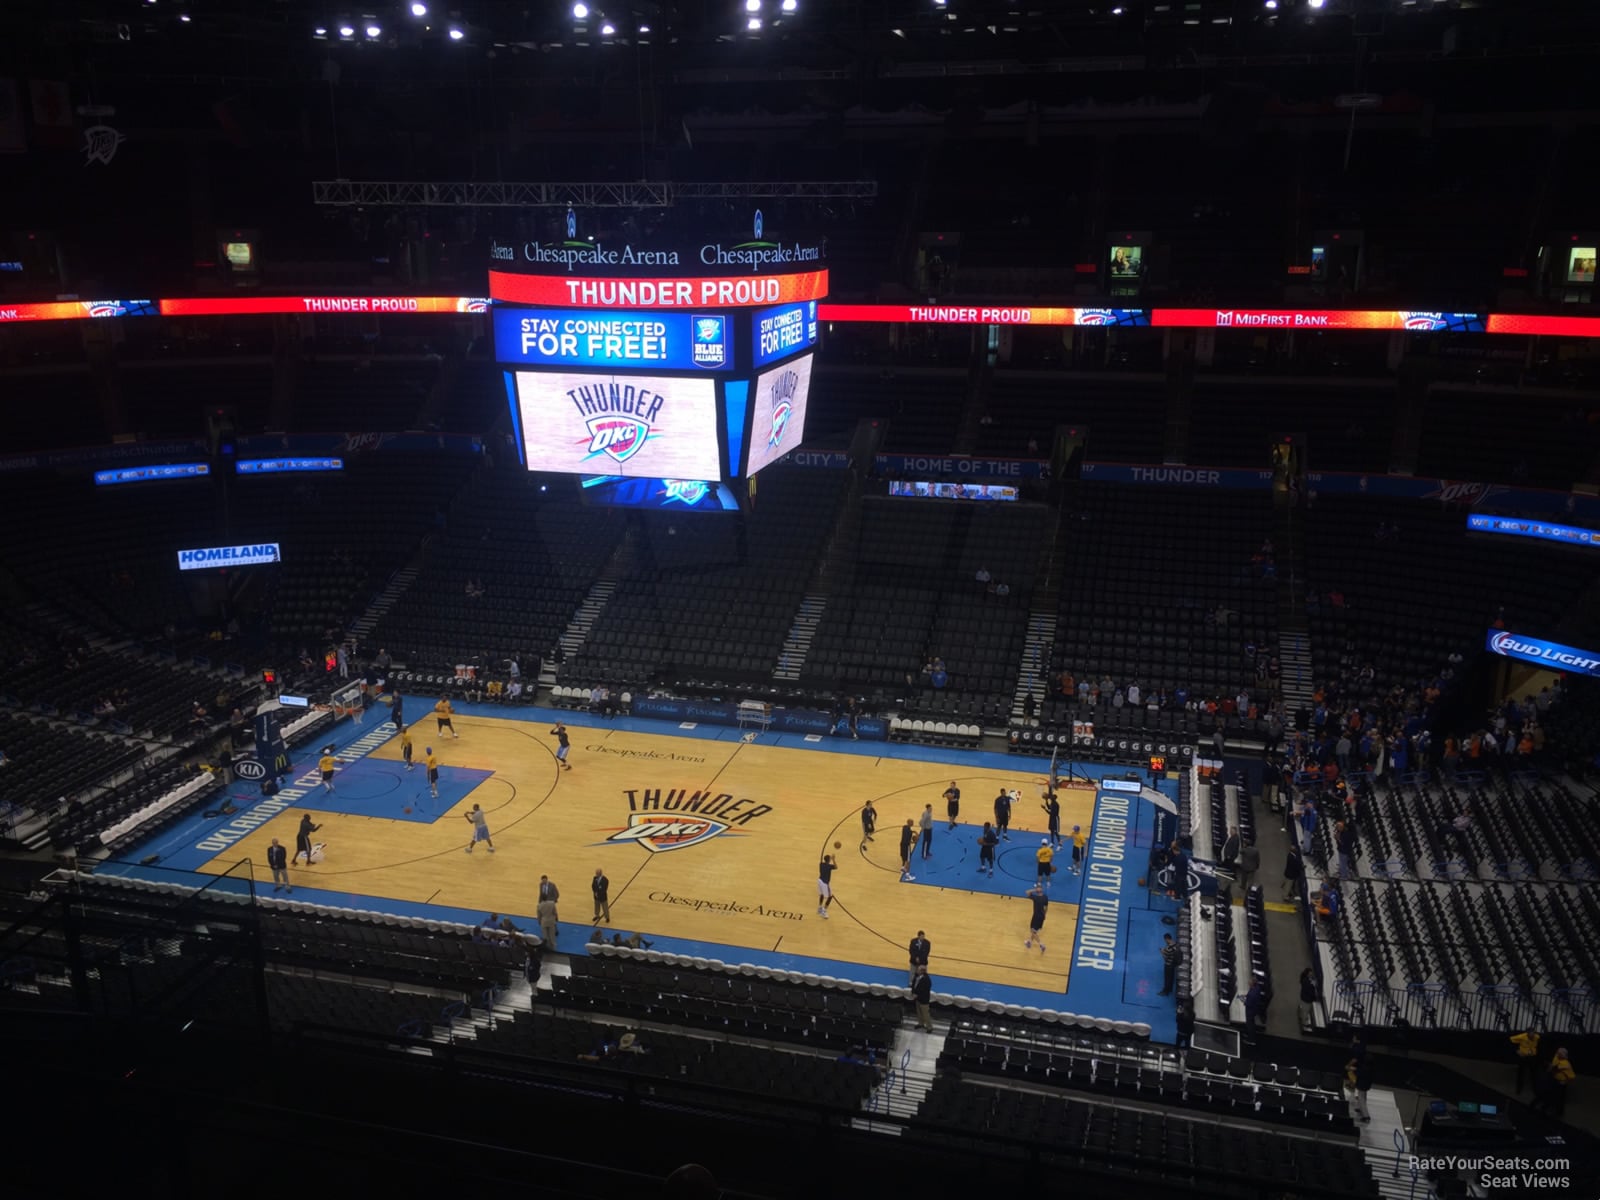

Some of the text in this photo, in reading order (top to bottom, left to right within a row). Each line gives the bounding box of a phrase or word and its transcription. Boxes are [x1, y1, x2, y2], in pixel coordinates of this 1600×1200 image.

[524, 241, 679, 271] Chesapeake Arena
[700, 243, 792, 271] Chesapeake
[793, 242, 819, 262] Arena
[566, 279, 780, 305] THUNDER PROUD
[303, 298, 417, 311] THUNDER PROUD
[761, 308, 803, 333] STAY CONNECTED
[910, 307, 1031, 322] THUNDER PROUD
[521, 318, 666, 336] STAY CONNECTED
[521, 333, 667, 359] FOR FREE!
[760, 330, 780, 357] FOR
[780, 322, 803, 349] FREE!
[695, 343, 723, 354] BLUE
[695, 354, 723, 362] ALLIANCE
[566, 383, 665, 423] THUNDER
[588, 423, 636, 453] OKC
[795, 453, 832, 466] CITY
[903, 457, 1021, 476] HOME OF THE
[1130, 467, 1220, 484] THUNDER
[1493, 520, 1530, 533] KNOW
[181, 545, 275, 563] HOMELAND
[1499, 638, 1600, 670] BUD LIGHT
[1011, 730, 1019, 739] G
[1023, 732, 1030, 740] G
[1035, 733, 1042, 741] G
[1047, 734, 1054, 742] G
[1058, 735, 1066, 743] G
[1083, 737, 1091, 746] G
[1107, 740, 1115, 748] G
[1119, 741, 1127, 749] G
[1132, 742, 1140, 751] G
[1144, 744, 1152, 752] G
[1159, 744, 1166, 752] G
[1170, 746, 1178, 755] G
[1182, 747, 1191, 756] G
[585, 744, 706, 763] Chesapeake Arena
[239, 764, 261, 776] KIA
[623, 789, 773, 825] THUNDER
[196, 787, 310, 852] OKLAHOMA
[610, 822, 707, 840] OKC
[1092, 796, 1130, 861] OKLAHOMA
[1088, 861, 1123, 895] CITY
[648, 891, 750, 912] Chesapeake
[749, 904, 804, 921] Arena
[1076, 896, 1120, 972] THUNDER
